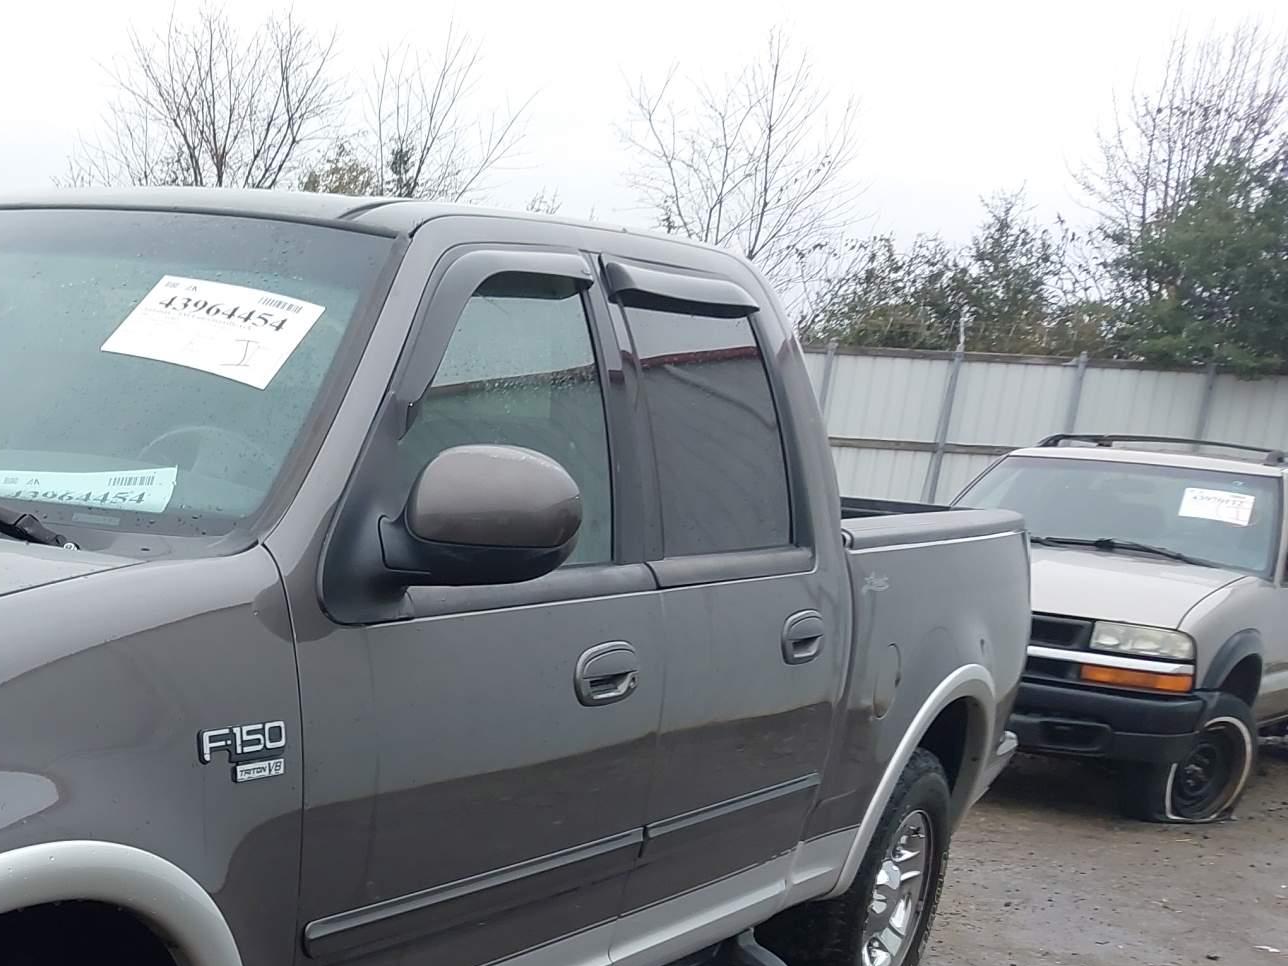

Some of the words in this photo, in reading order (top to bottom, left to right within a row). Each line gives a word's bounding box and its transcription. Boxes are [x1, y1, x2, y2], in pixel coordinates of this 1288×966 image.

[159, 294, 289, 332] 43964454
[239, 765, 267, 777] TRITON
[268, 760, 282, 775] V8
